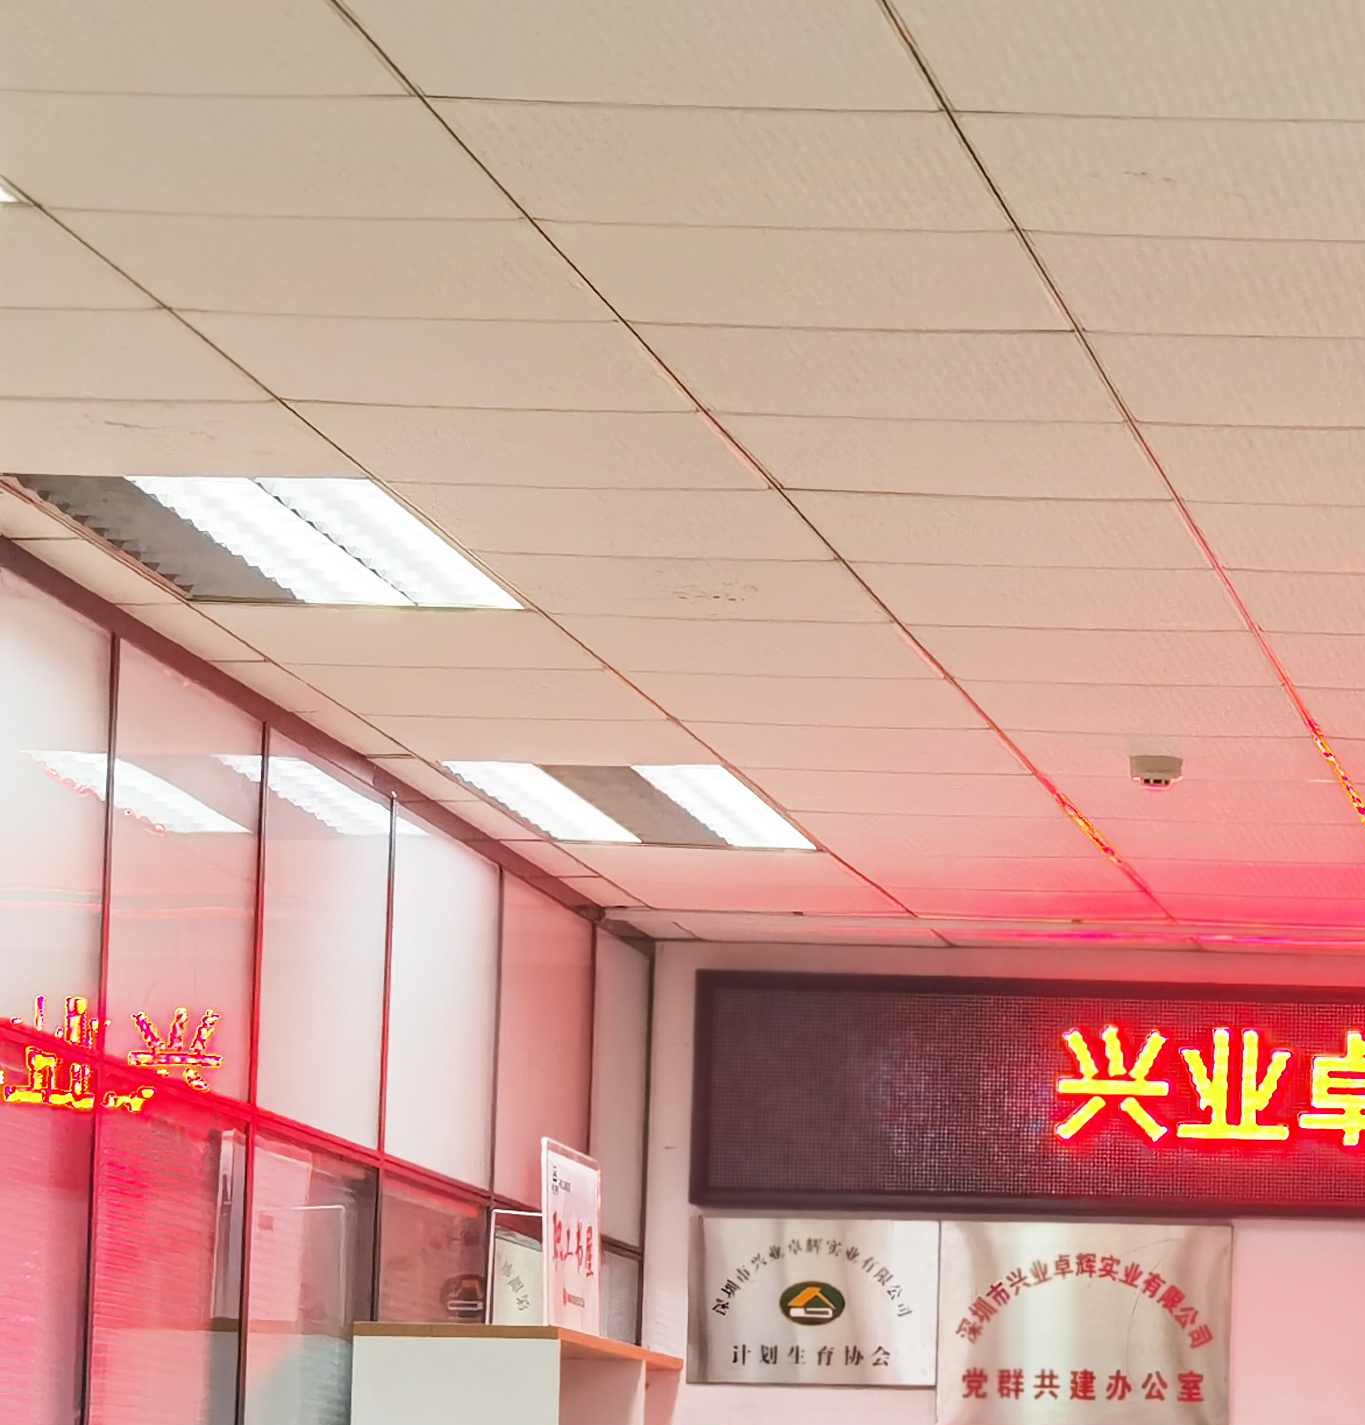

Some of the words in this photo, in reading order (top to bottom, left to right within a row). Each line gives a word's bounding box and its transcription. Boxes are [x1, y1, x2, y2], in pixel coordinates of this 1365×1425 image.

[712, 1238, 913, 1317] 深圳市兴业卓辉实业有限公司
[955, 1252, 1213, 1349] 深圳市兴业卓辉实业有限公司
[732, 1344, 891, 1367] 计划生育协会
[961, 1366, 1205, 1403] 党群共建办公室
